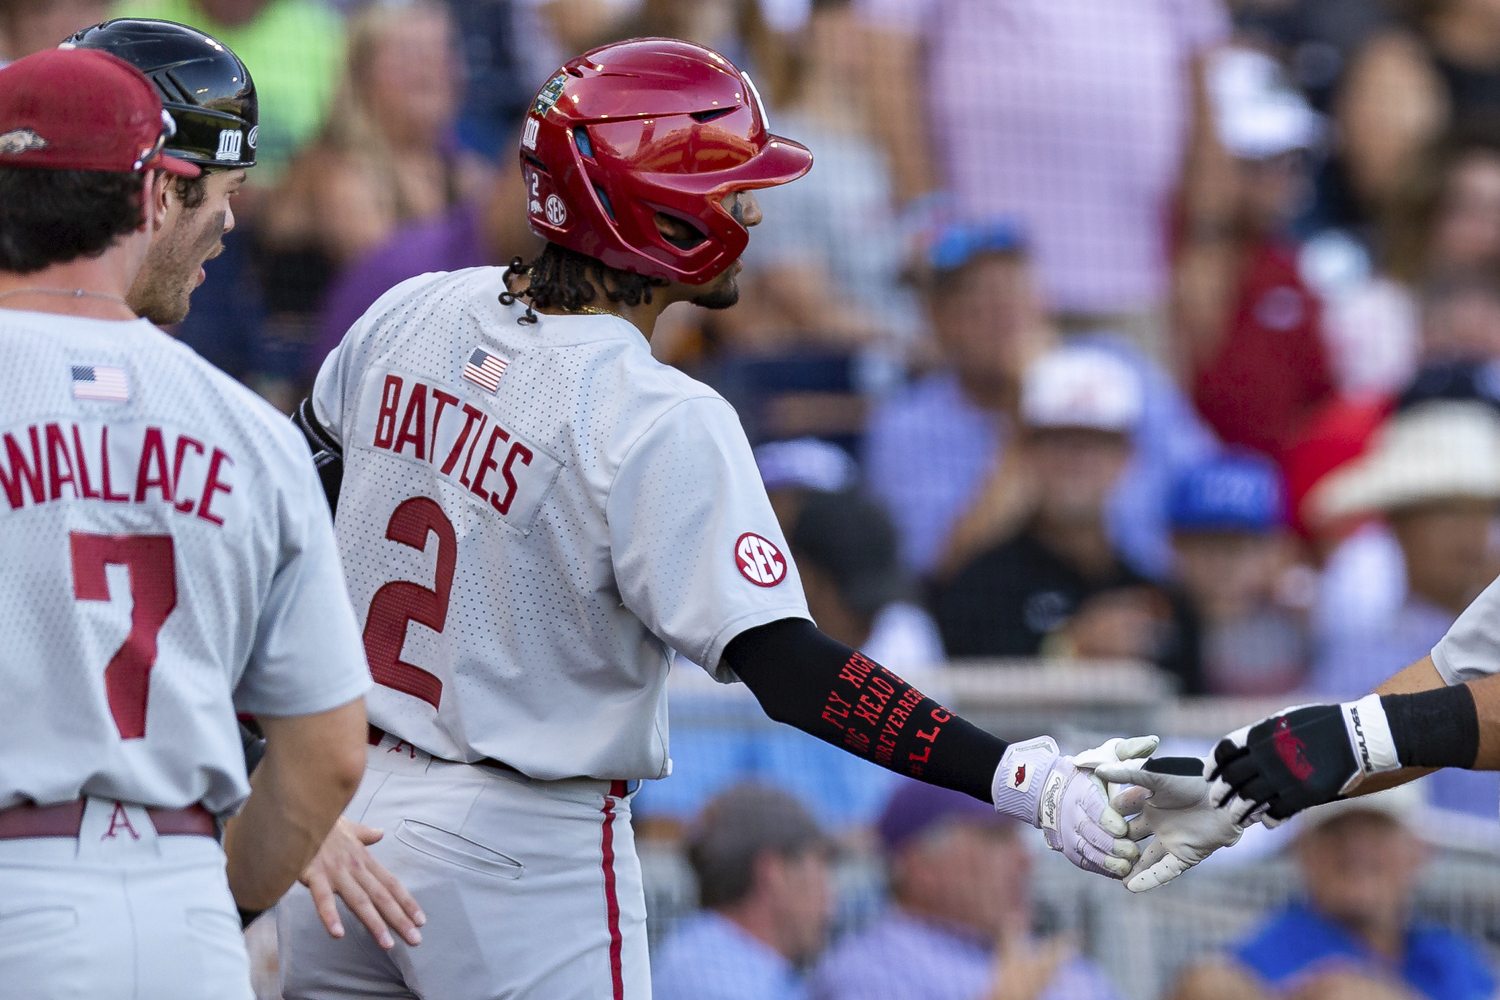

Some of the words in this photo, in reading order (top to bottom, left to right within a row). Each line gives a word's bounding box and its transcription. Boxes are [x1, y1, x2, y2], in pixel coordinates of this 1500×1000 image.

[532, 172, 540, 197] 2
[547, 194, 565, 224] SEC
[0, 422, 234, 527] WALLACE
[373, 374, 534, 516] BATTLES
[738, 535, 784, 584] SEC
[69, 530, 178, 740] 7
[362, 495, 458, 713] 2
[821, 691, 852, 730] FLY
[838, 651, 877, 689] HIGH
[853, 676, 895, 726] HEAD
[101, 801, 141, 841] A
